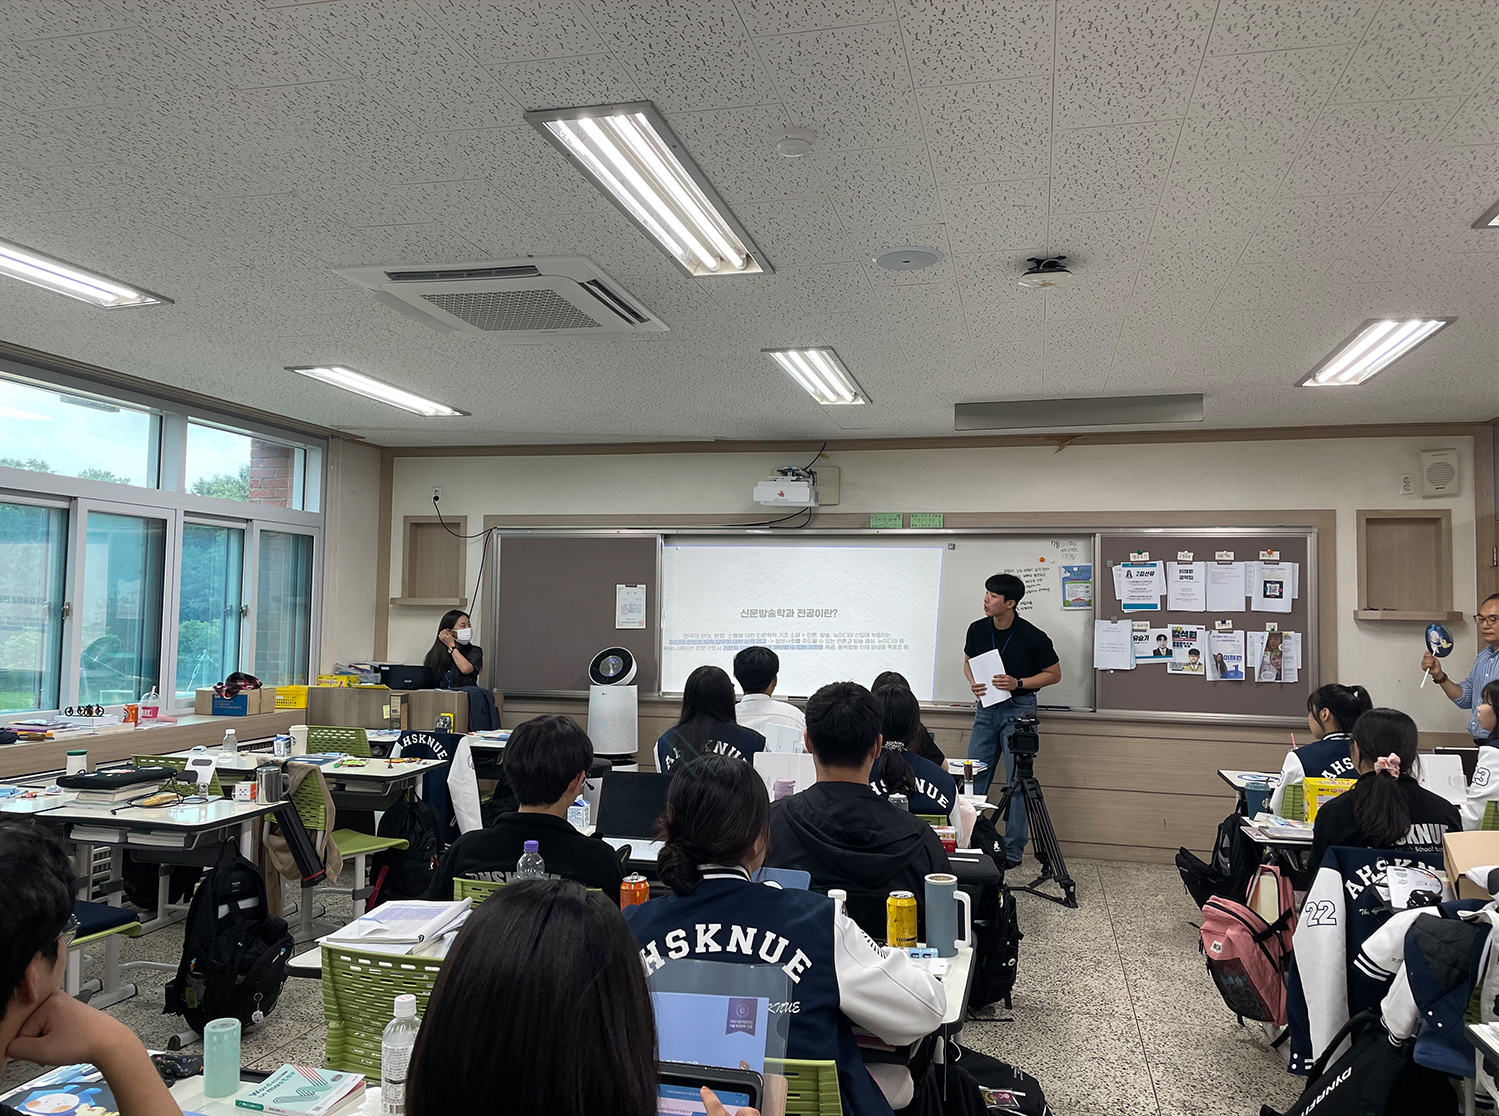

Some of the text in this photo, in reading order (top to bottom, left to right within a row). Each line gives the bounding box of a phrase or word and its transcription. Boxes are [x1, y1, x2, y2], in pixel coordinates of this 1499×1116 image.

[740, 608, 838, 618] 신문방송학과 전공이란?
[1304, 900, 1338, 928] 22
